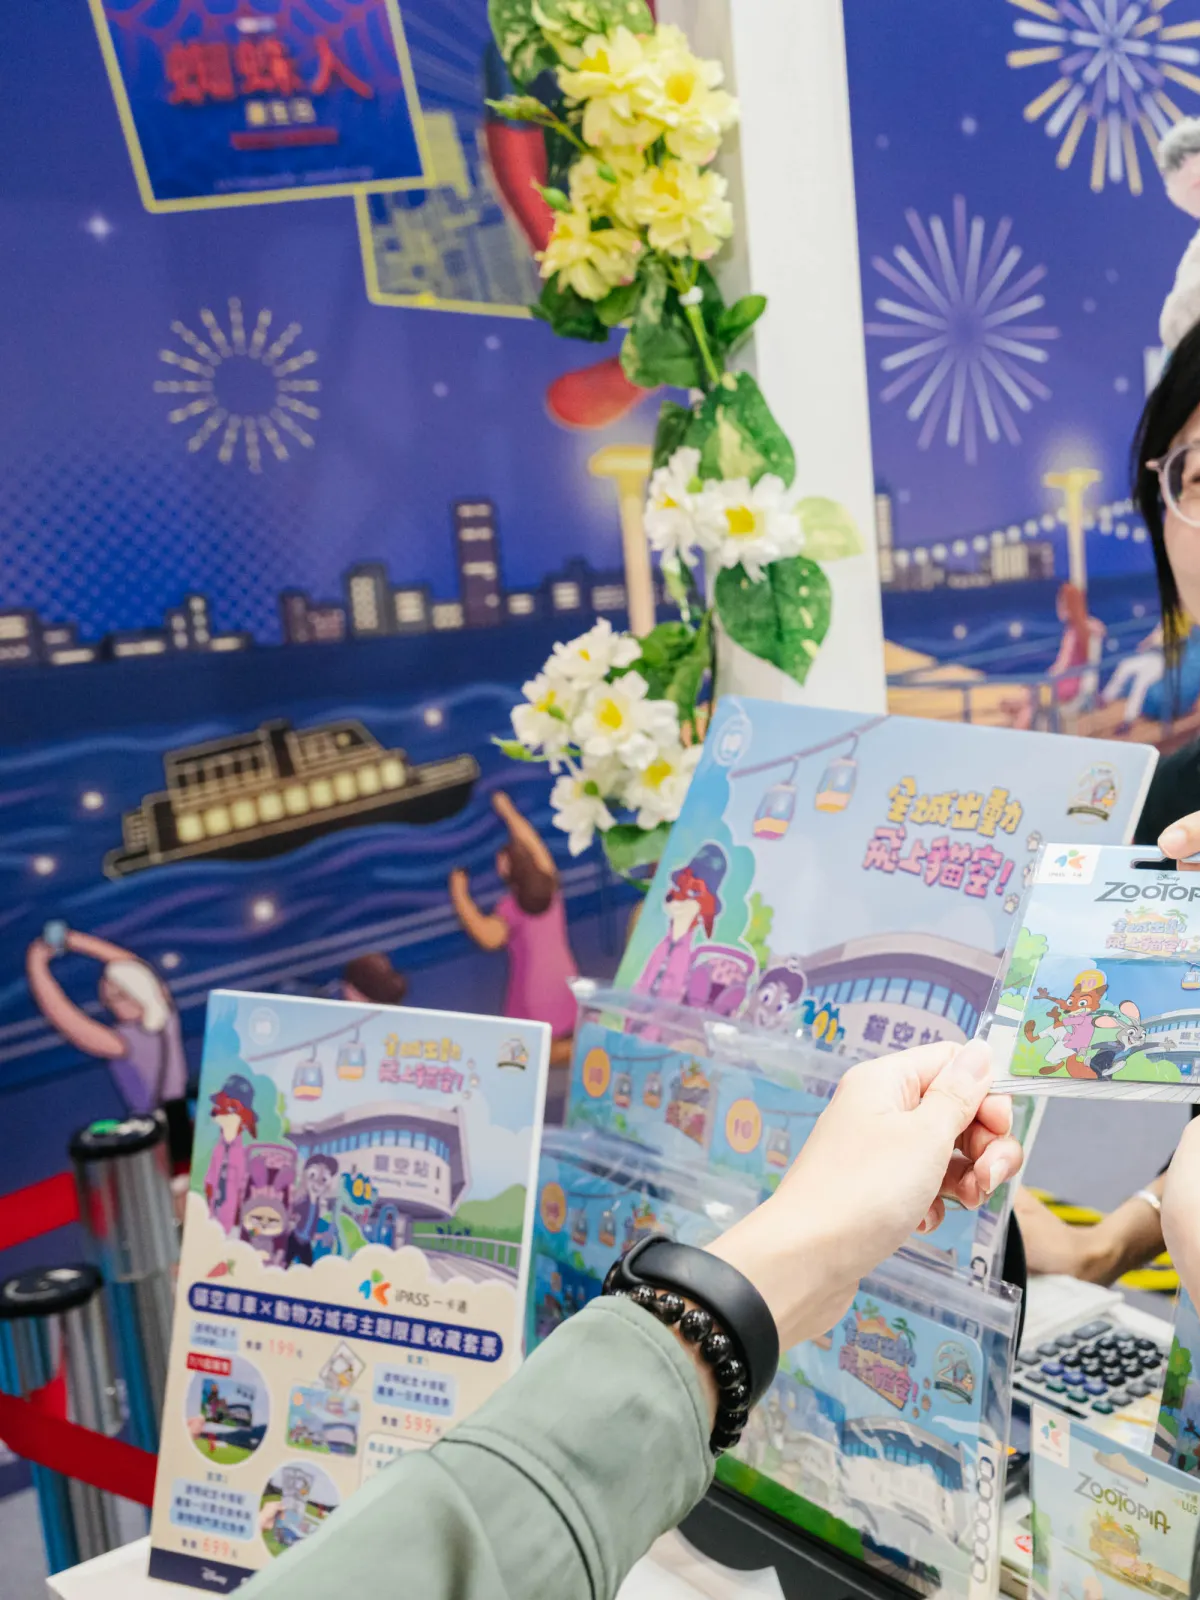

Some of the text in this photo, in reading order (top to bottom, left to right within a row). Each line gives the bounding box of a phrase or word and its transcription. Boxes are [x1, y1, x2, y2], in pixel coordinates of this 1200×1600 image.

[887, 776, 1023, 838] 全城出動
[1074, 1471, 1171, 1534] ZOOTOPIA
